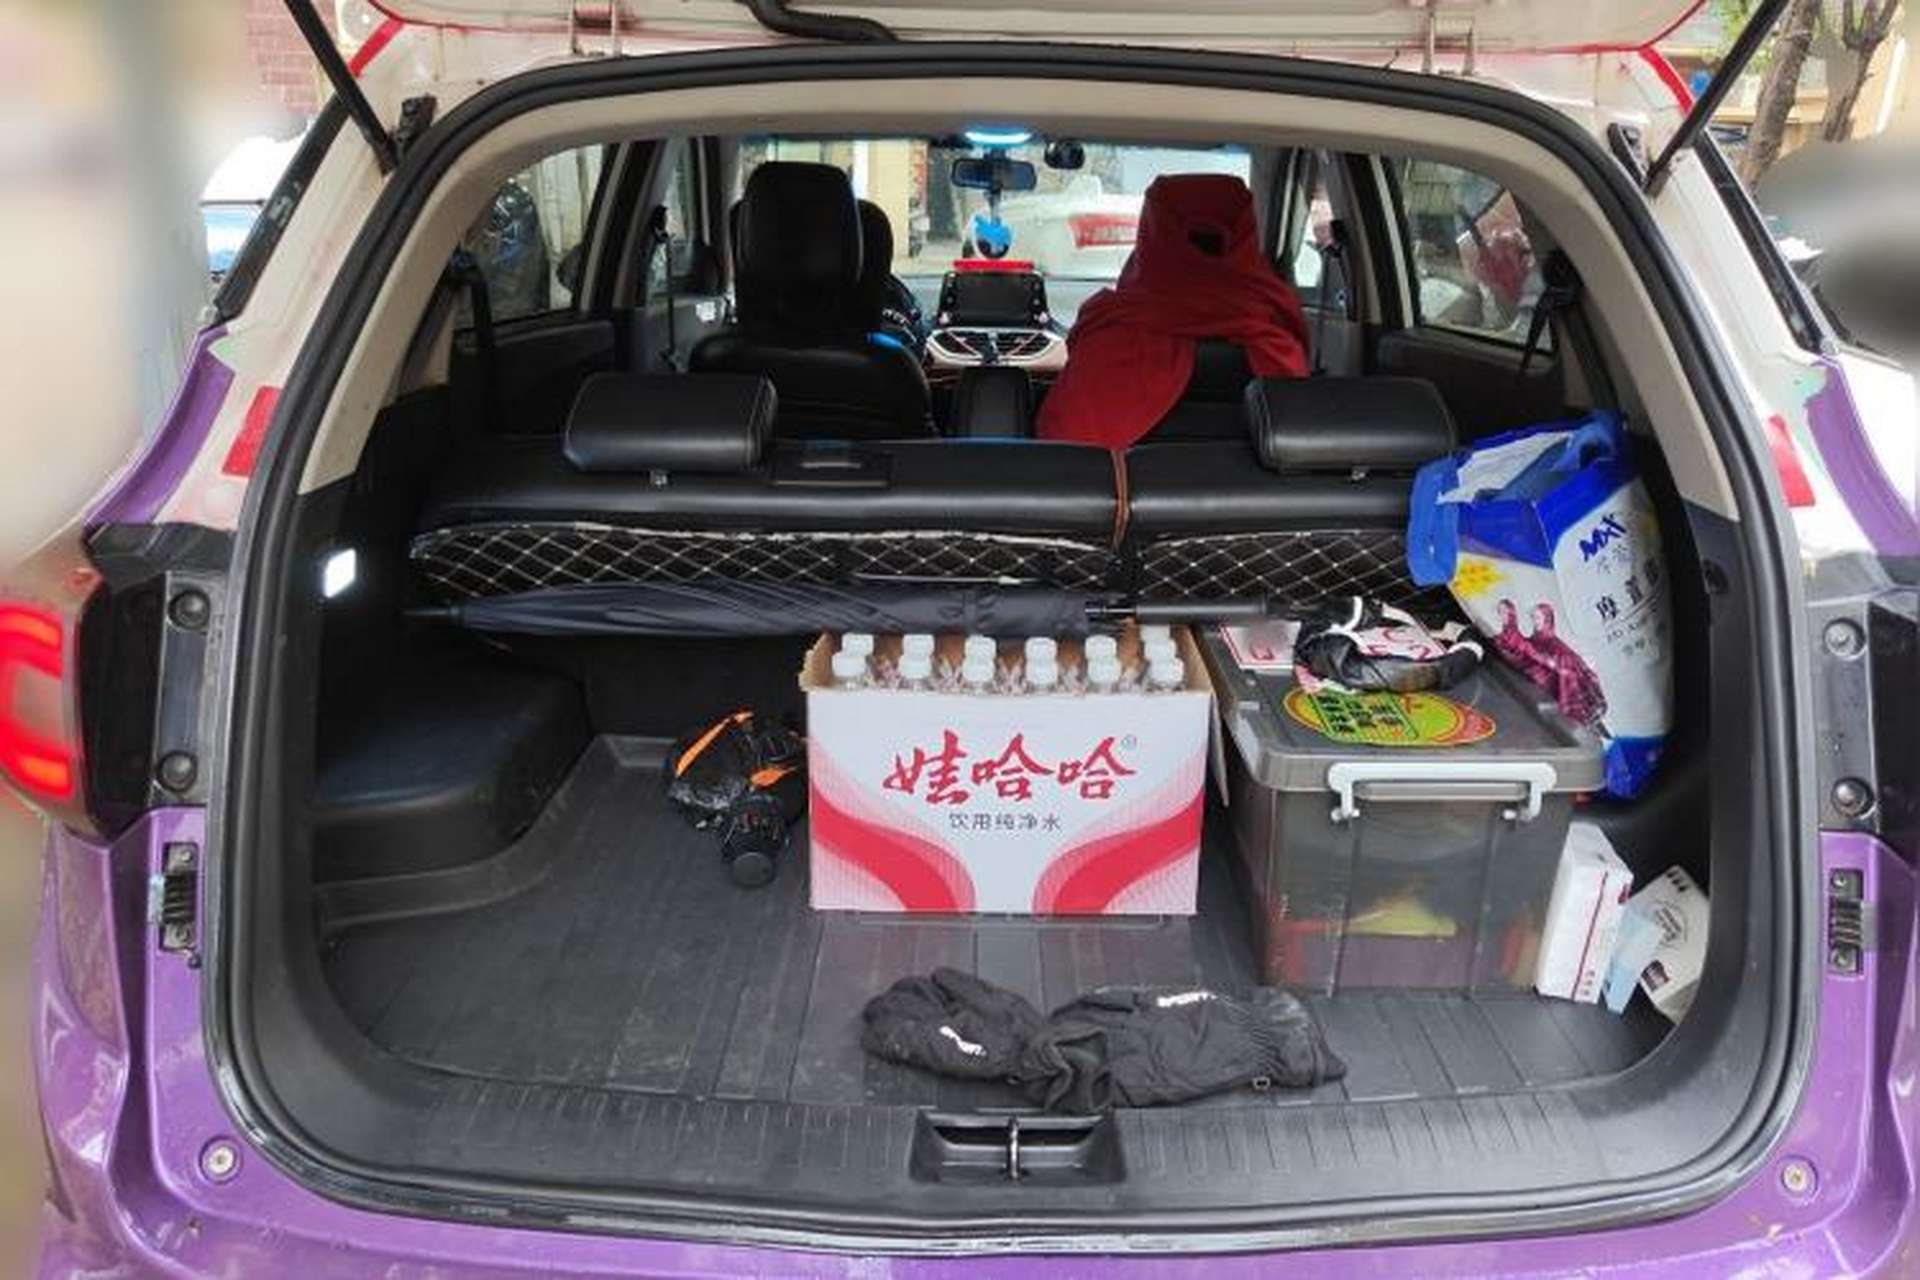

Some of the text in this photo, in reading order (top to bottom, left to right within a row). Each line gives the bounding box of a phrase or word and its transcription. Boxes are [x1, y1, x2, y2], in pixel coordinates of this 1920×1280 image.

[883, 730, 1136, 804] 娃哈哈
[949, 812, 1062, 831] 饮用纯净水
